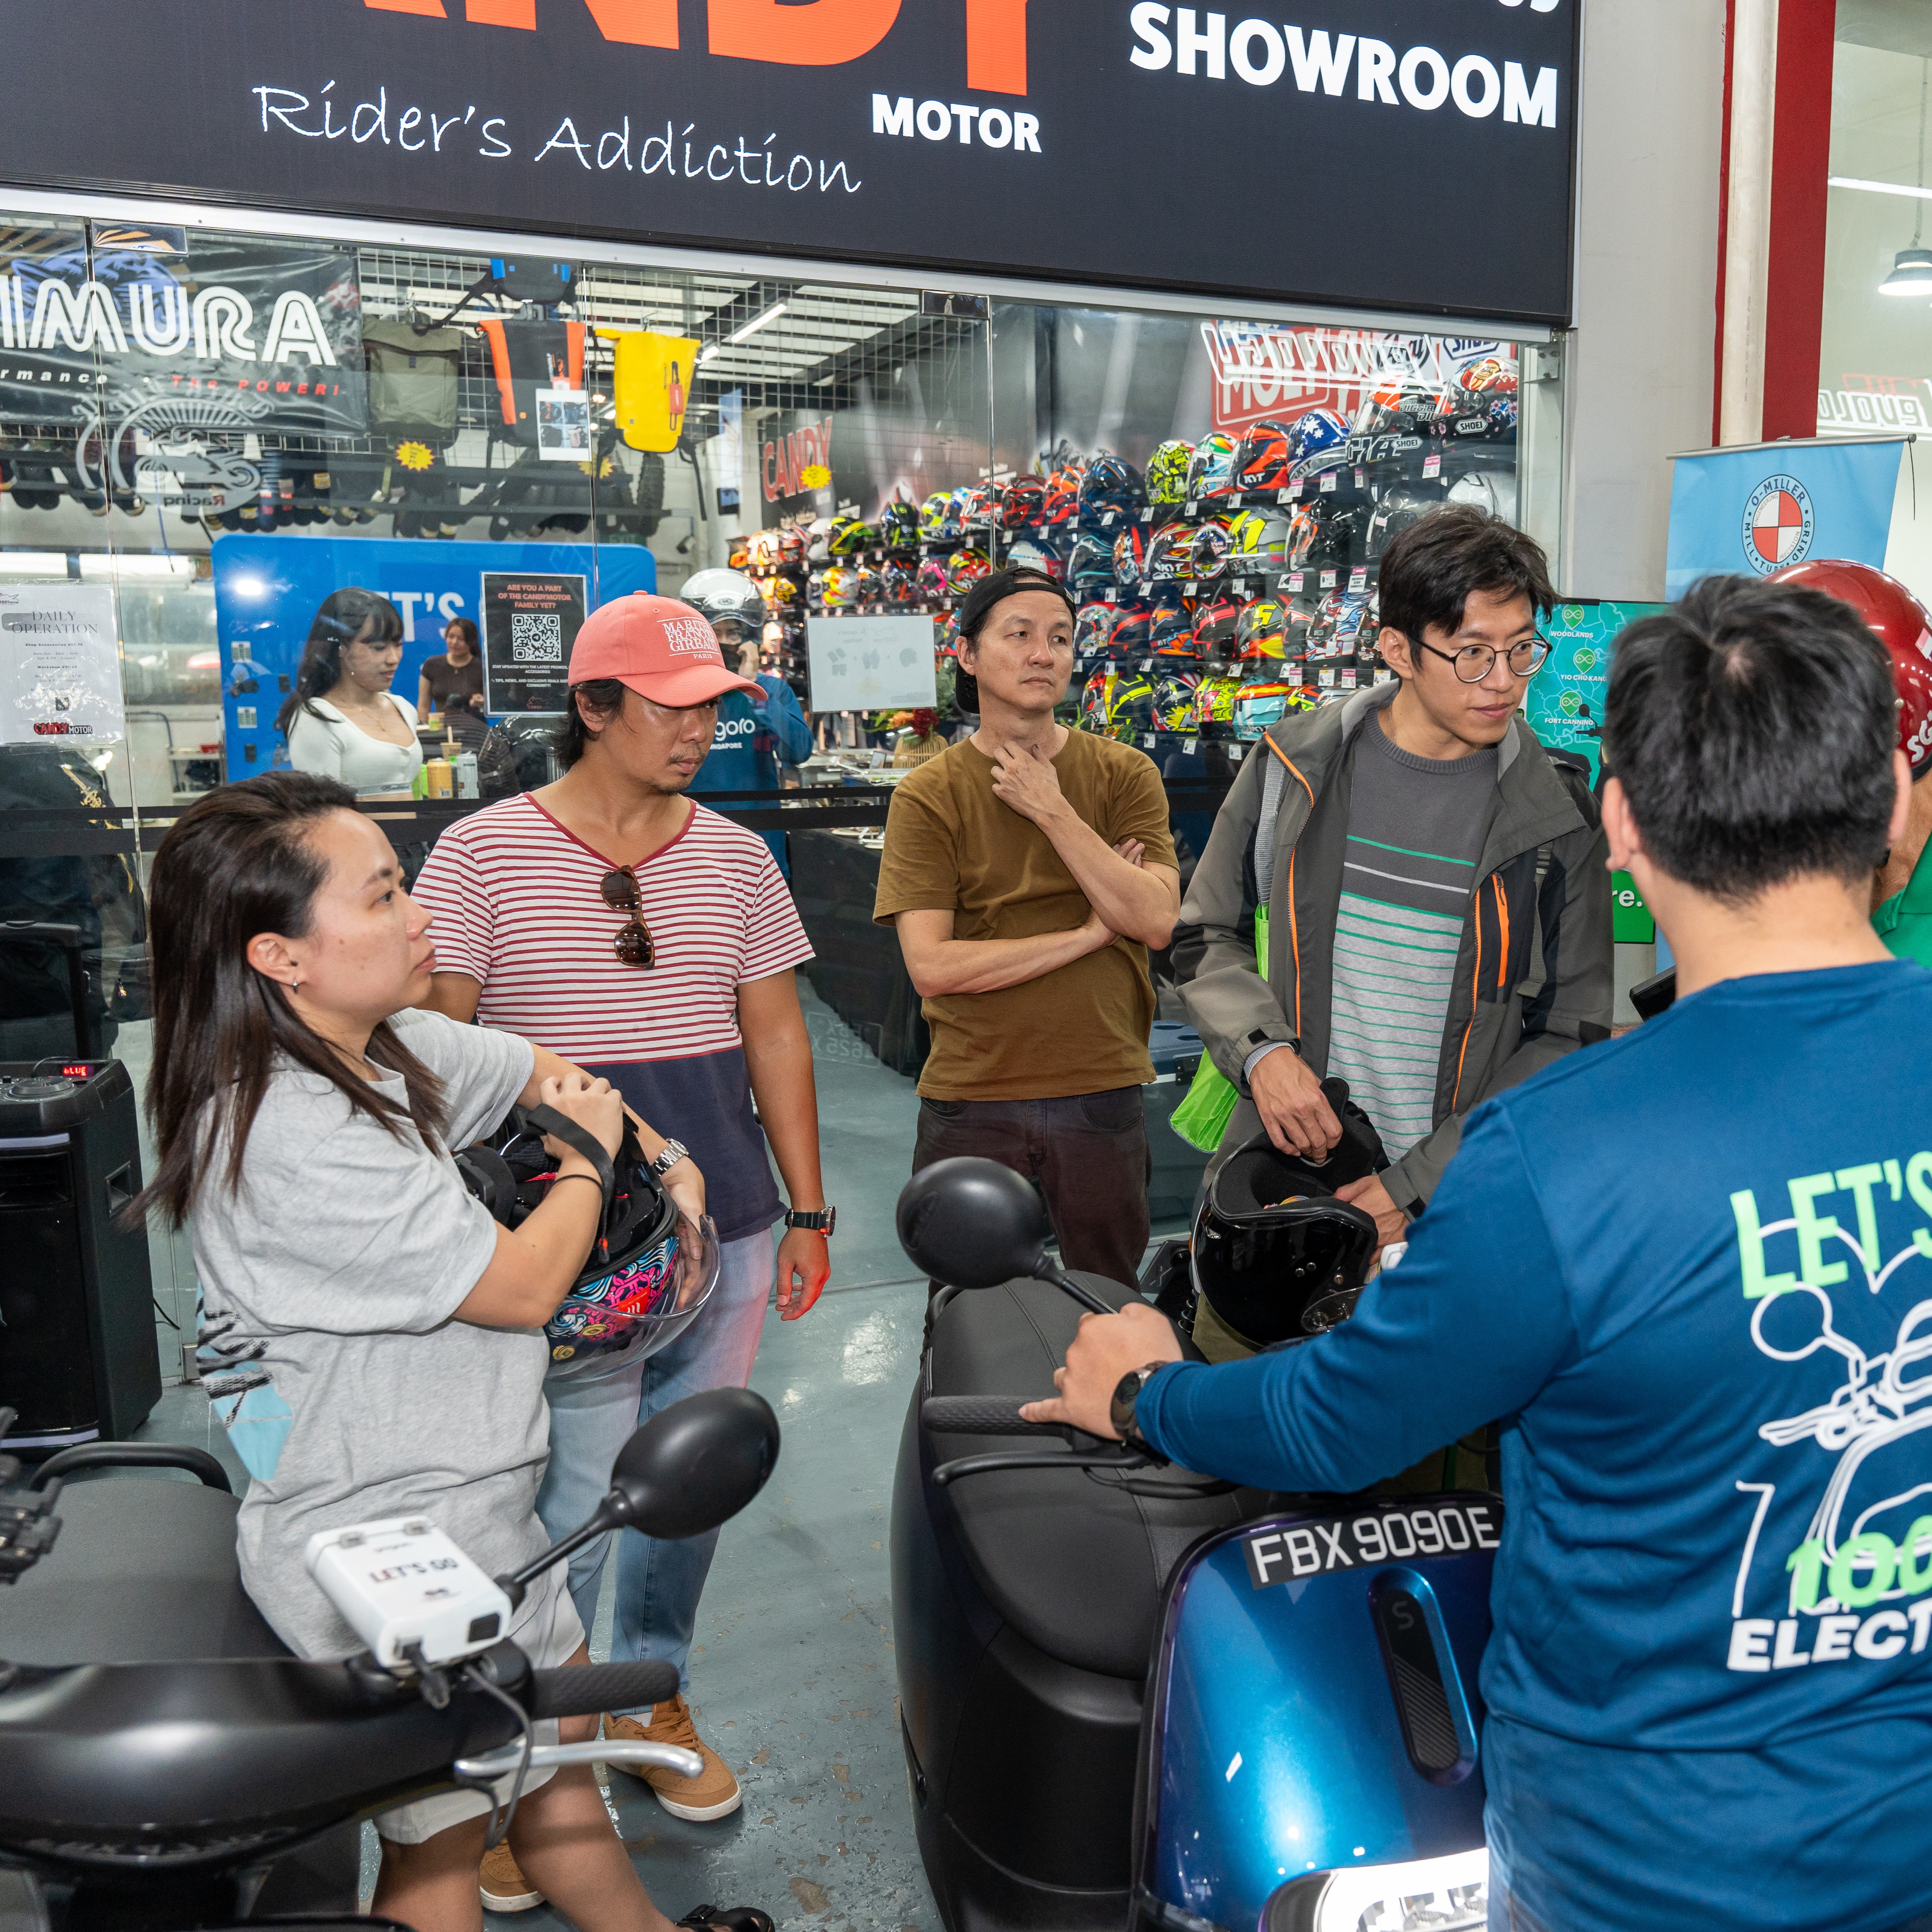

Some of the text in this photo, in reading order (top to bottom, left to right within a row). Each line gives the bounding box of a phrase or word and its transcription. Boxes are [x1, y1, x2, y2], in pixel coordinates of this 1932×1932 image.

[1130, 1, 1557, 128] SHOWROOM
[252, 80, 861, 192] Rider's Addiction
[873, 93, 1042, 153] MOTOR
[238, 380, 339, 396] POWER!
[1461, 421, 1482, 430] SHOEI
[763, 416, 833, 502] CANDY
[1243, 472, 1265, 483] KYT
[1752, 478, 1805, 506] O-MILLER
[1754, 493, 1778, 526] ENGINEERING
[1745, 523, 1755, 557] MILL
[1779, 531, 1800, 560] PRECISION
[1792, 521, 1810, 561] GRIND
[12, 624, 98, 634] OPERATION
[32, 611, 76, 621] DAILY
[670, 638, 718, 652] GIRBAUD
[33, 722, 69, 734] CANDY
[715, 718, 756, 741] goro
[1251, 1506, 1500, 1583] FBX 9090E
